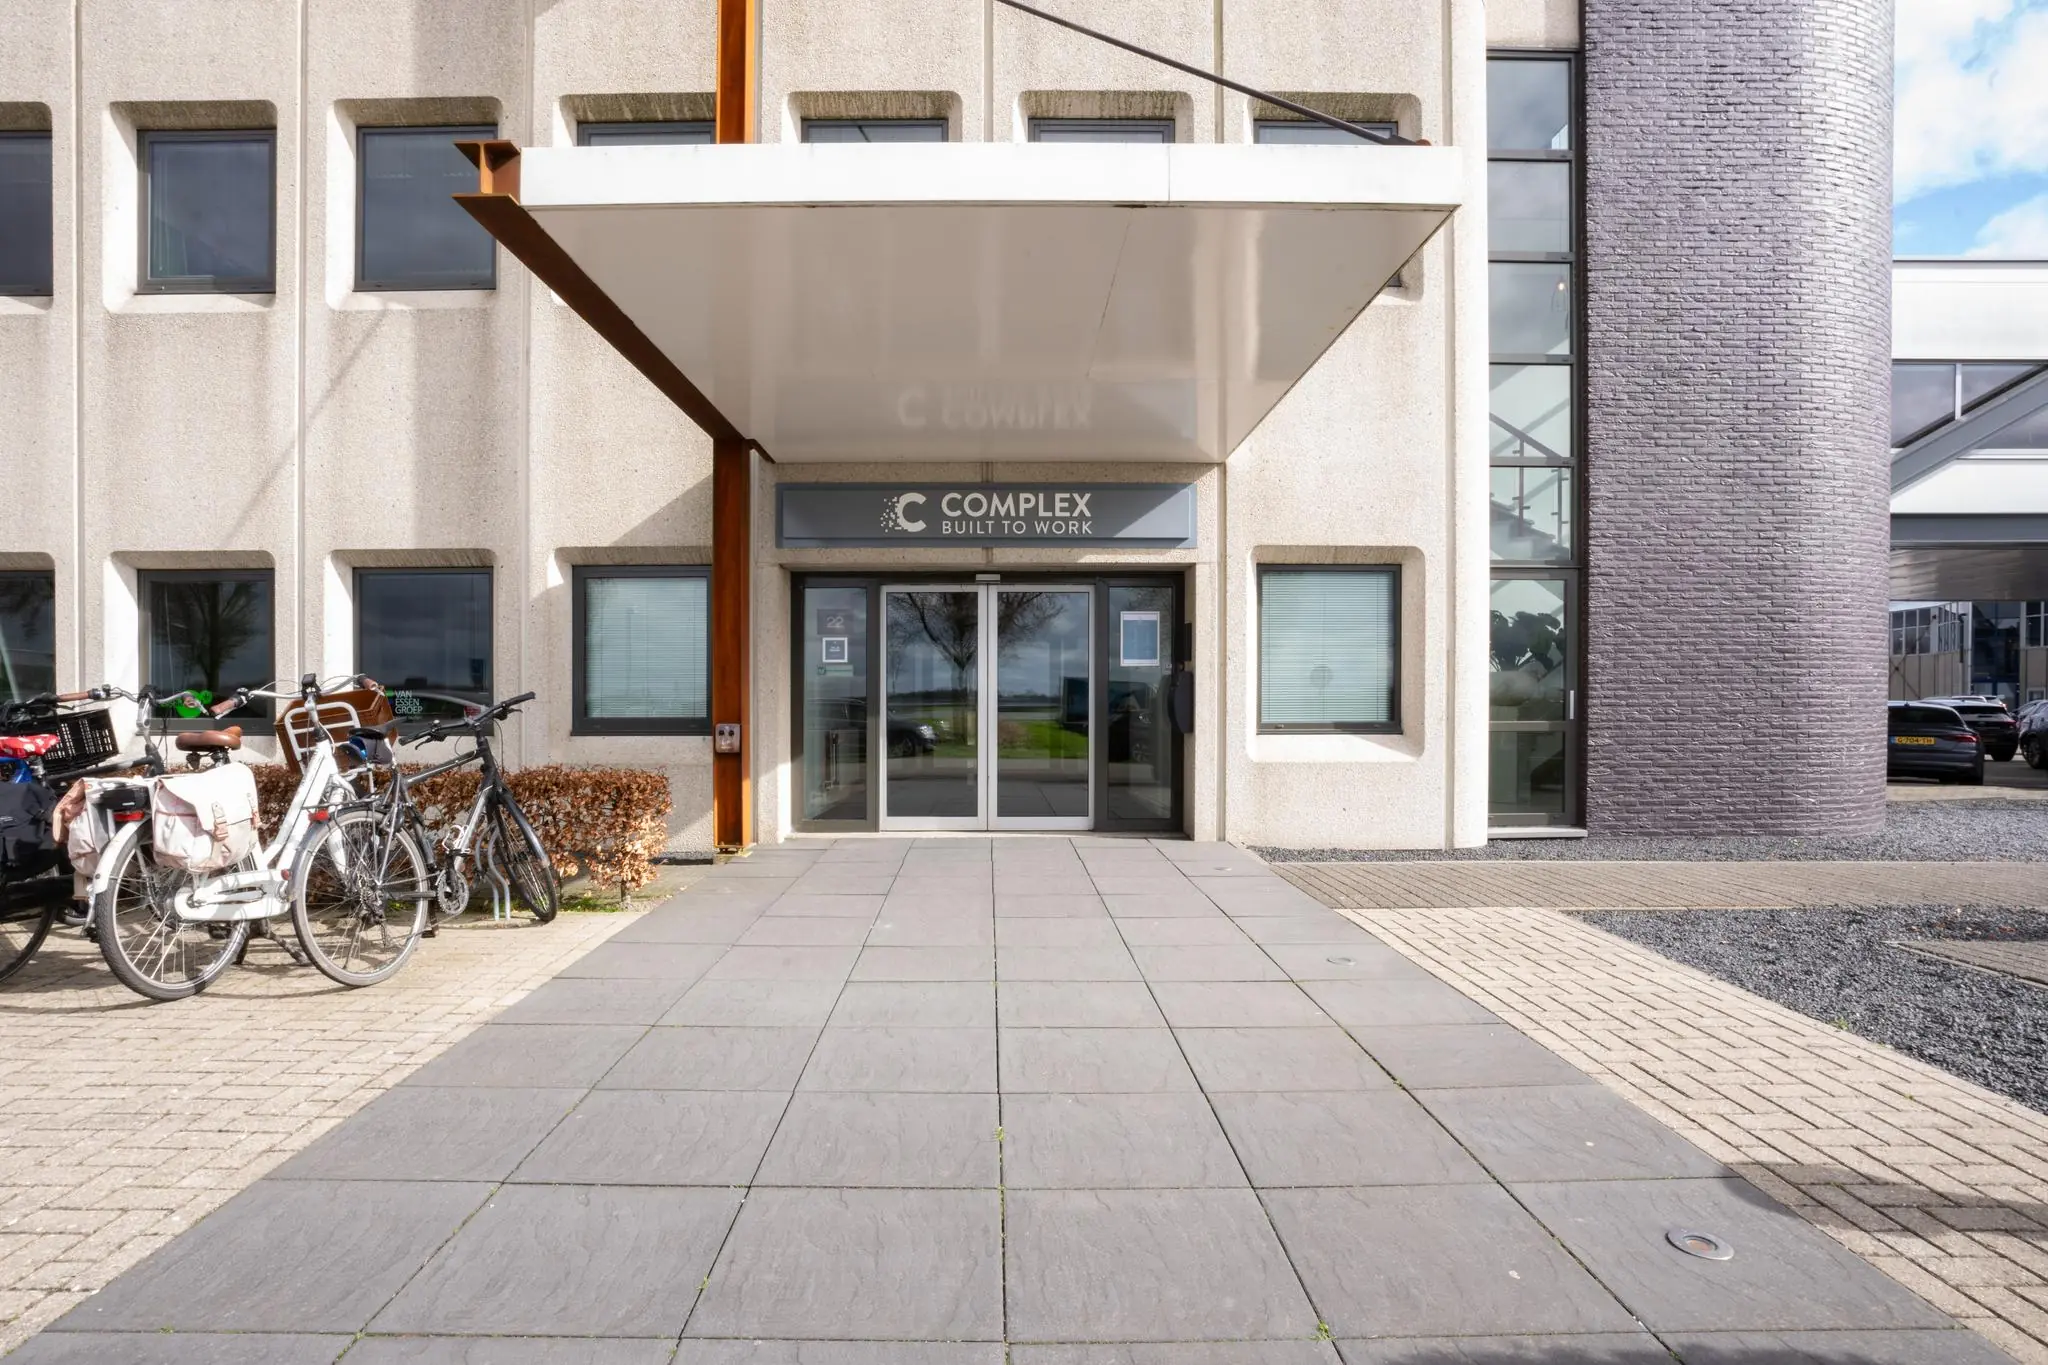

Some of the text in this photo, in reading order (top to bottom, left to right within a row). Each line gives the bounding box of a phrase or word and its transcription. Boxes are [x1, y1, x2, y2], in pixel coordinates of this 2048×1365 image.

[941, 492, 1092, 517] COMPLEX
[942, 520, 1093, 534] BUILT TO WORK
[826, 616, 844, 628] 22
[395, 690, 412, 698] VAN
[395, 698, 420, 706] ESSEN
[395, 706, 423, 714] GROEP
